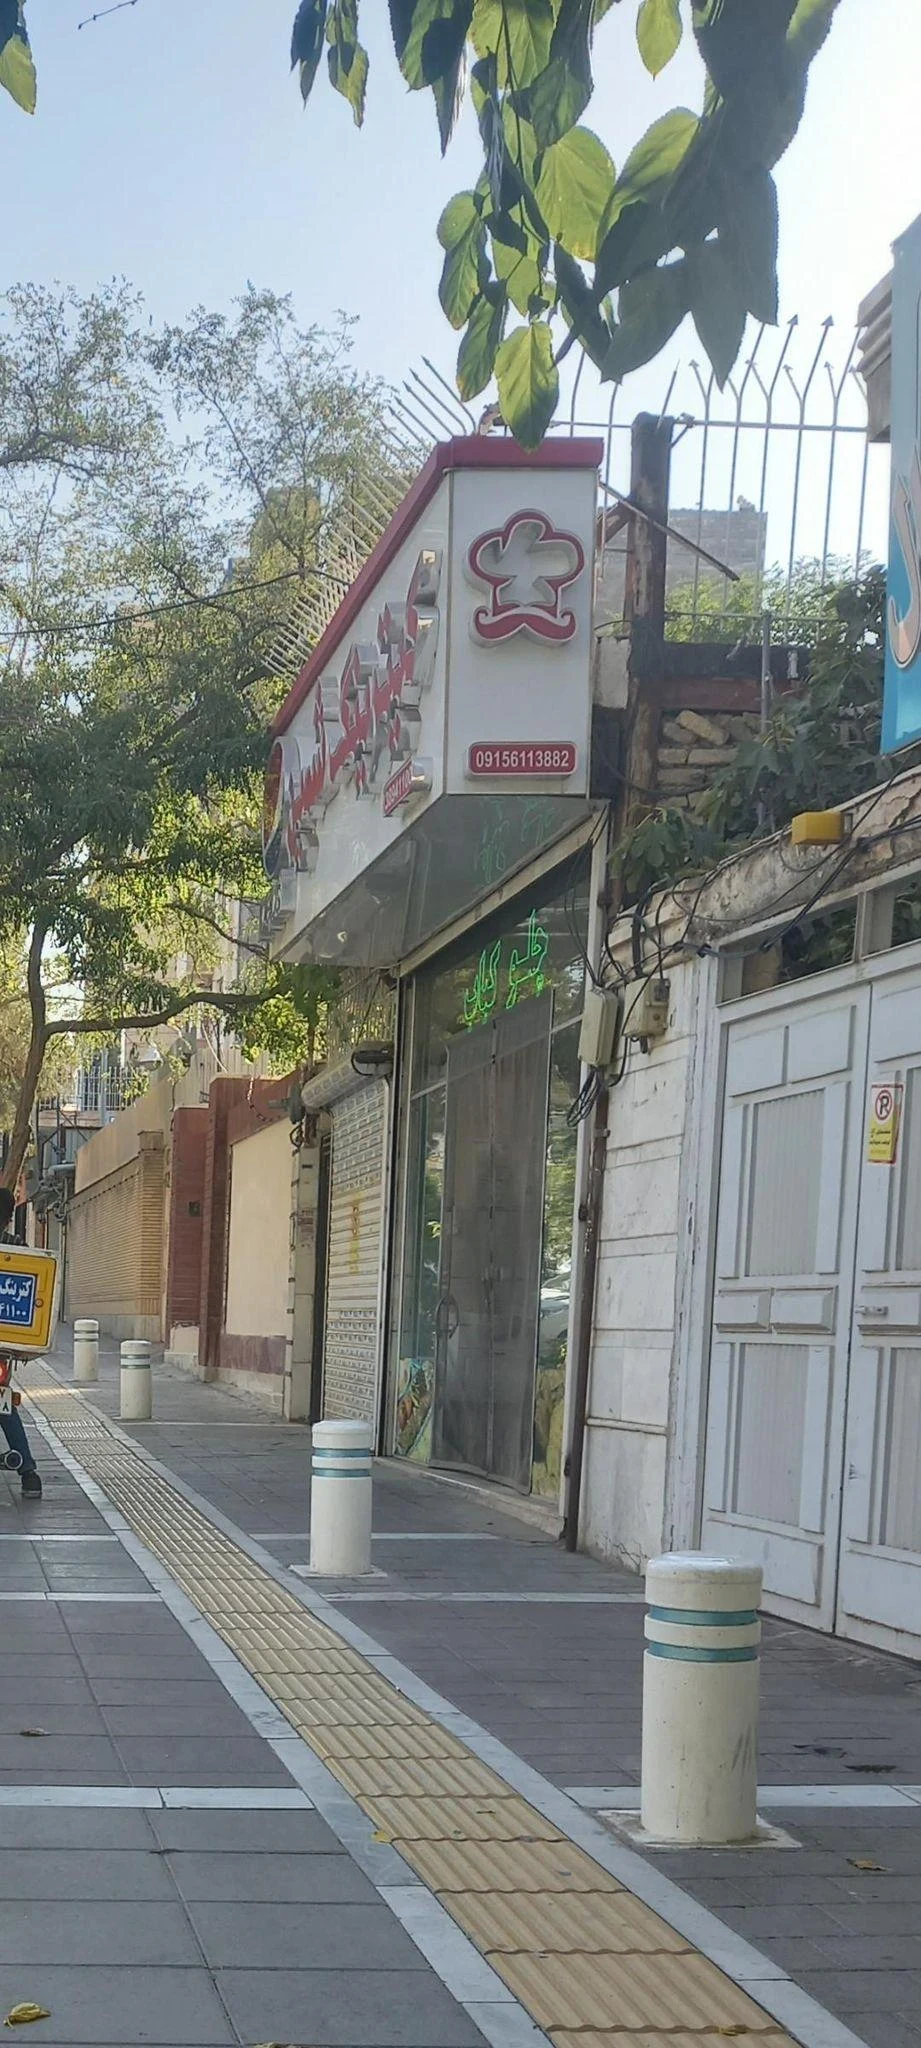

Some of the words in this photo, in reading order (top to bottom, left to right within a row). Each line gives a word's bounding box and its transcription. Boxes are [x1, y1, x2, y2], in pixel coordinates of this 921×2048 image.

[476, 750, 569, 767] 09156113882
[463, 939, 501, 1033] کباب
[505, 908, 549, 1009] چلو
